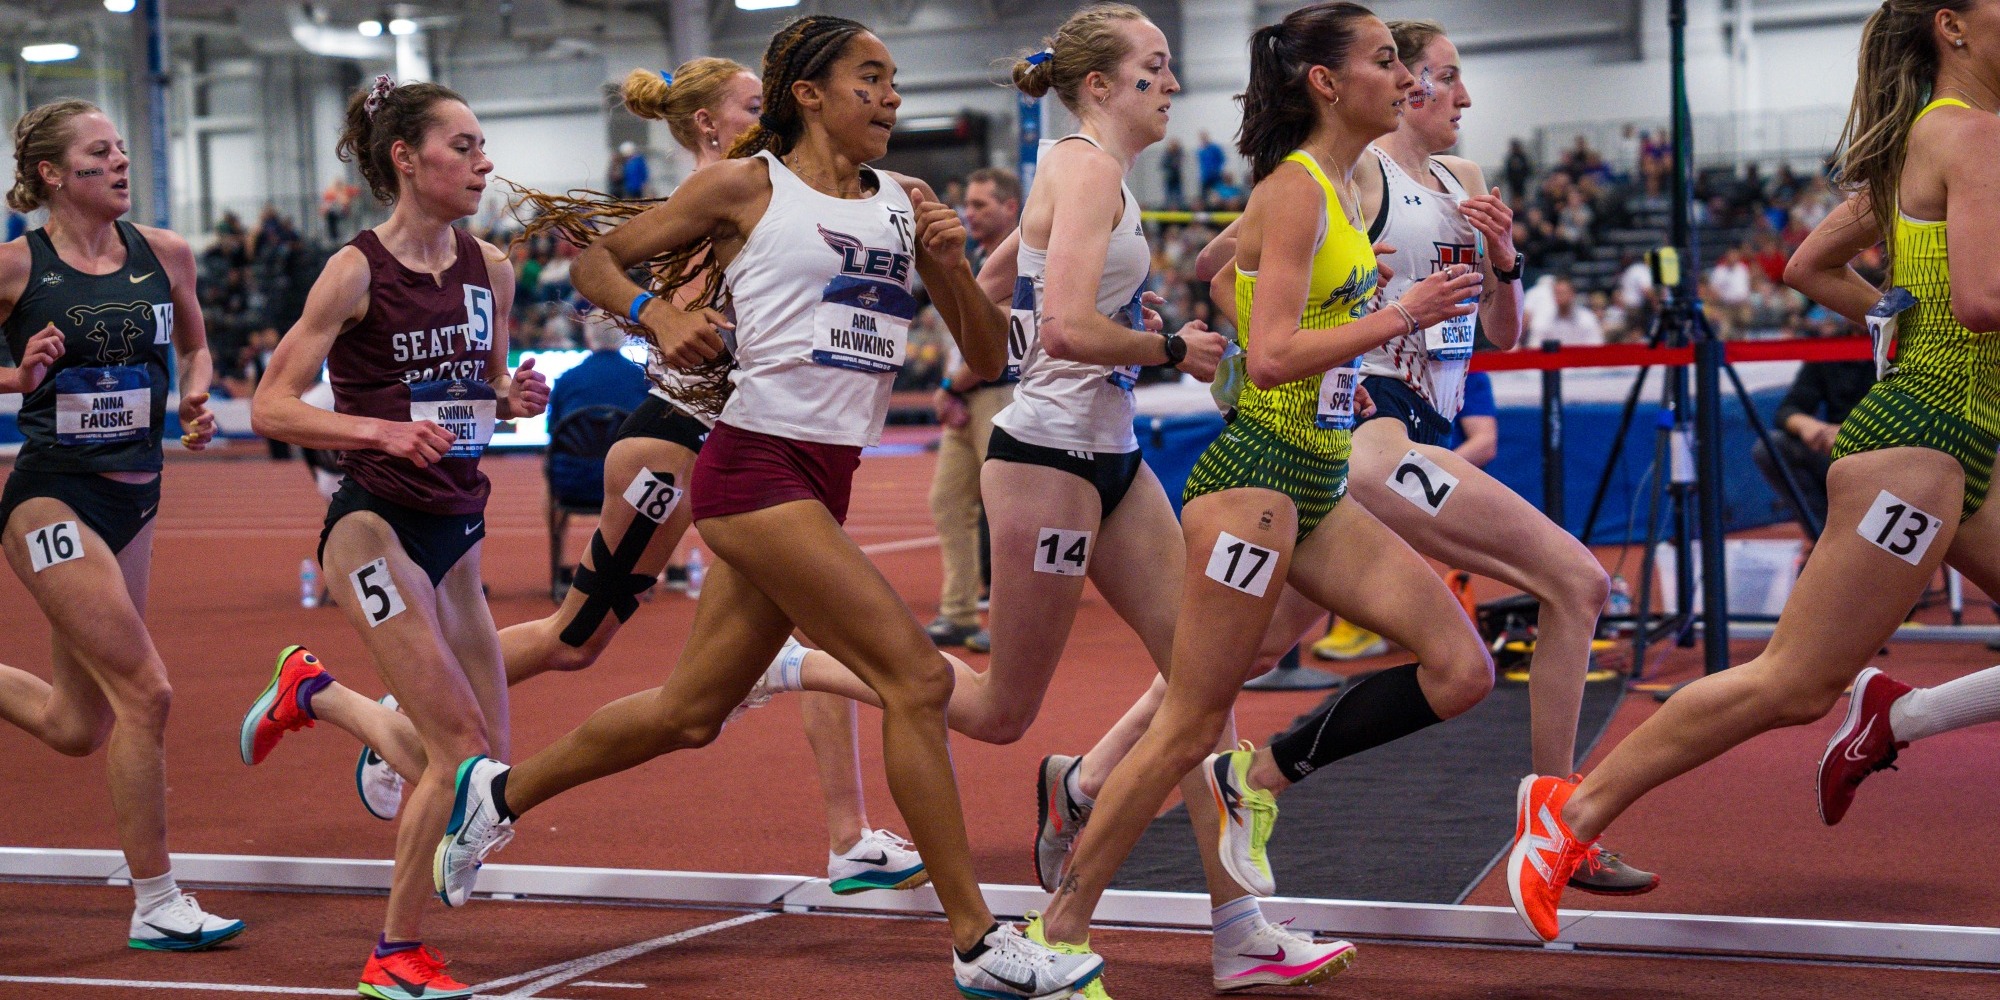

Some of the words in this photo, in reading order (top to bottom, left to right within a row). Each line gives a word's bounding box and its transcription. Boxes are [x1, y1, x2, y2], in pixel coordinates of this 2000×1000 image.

[889, 213, 915, 258] 15
[840, 246, 914, 286] LEE
[470, 288, 489, 341] 5
[851, 312, 878, 333] ARIA
[391, 323, 492, 362] SEATT
[830, 327, 895, 359] HAWKINS
[80, 410, 134, 429] FAUSKE
[92, 396, 124, 411] ANNA
[437, 405, 475, 420] ANNIKA
[437, 422, 477, 440] SVELT
[635, 480, 675, 520] 18
[1395, 462, 1451, 509] 2
[35, 523, 74, 564] 16
[1875, 503, 1929, 555] 13
[1040, 533, 1087, 567] 14
[1223, 541, 1271, 589] 17
[356, 564, 391, 622] 5
